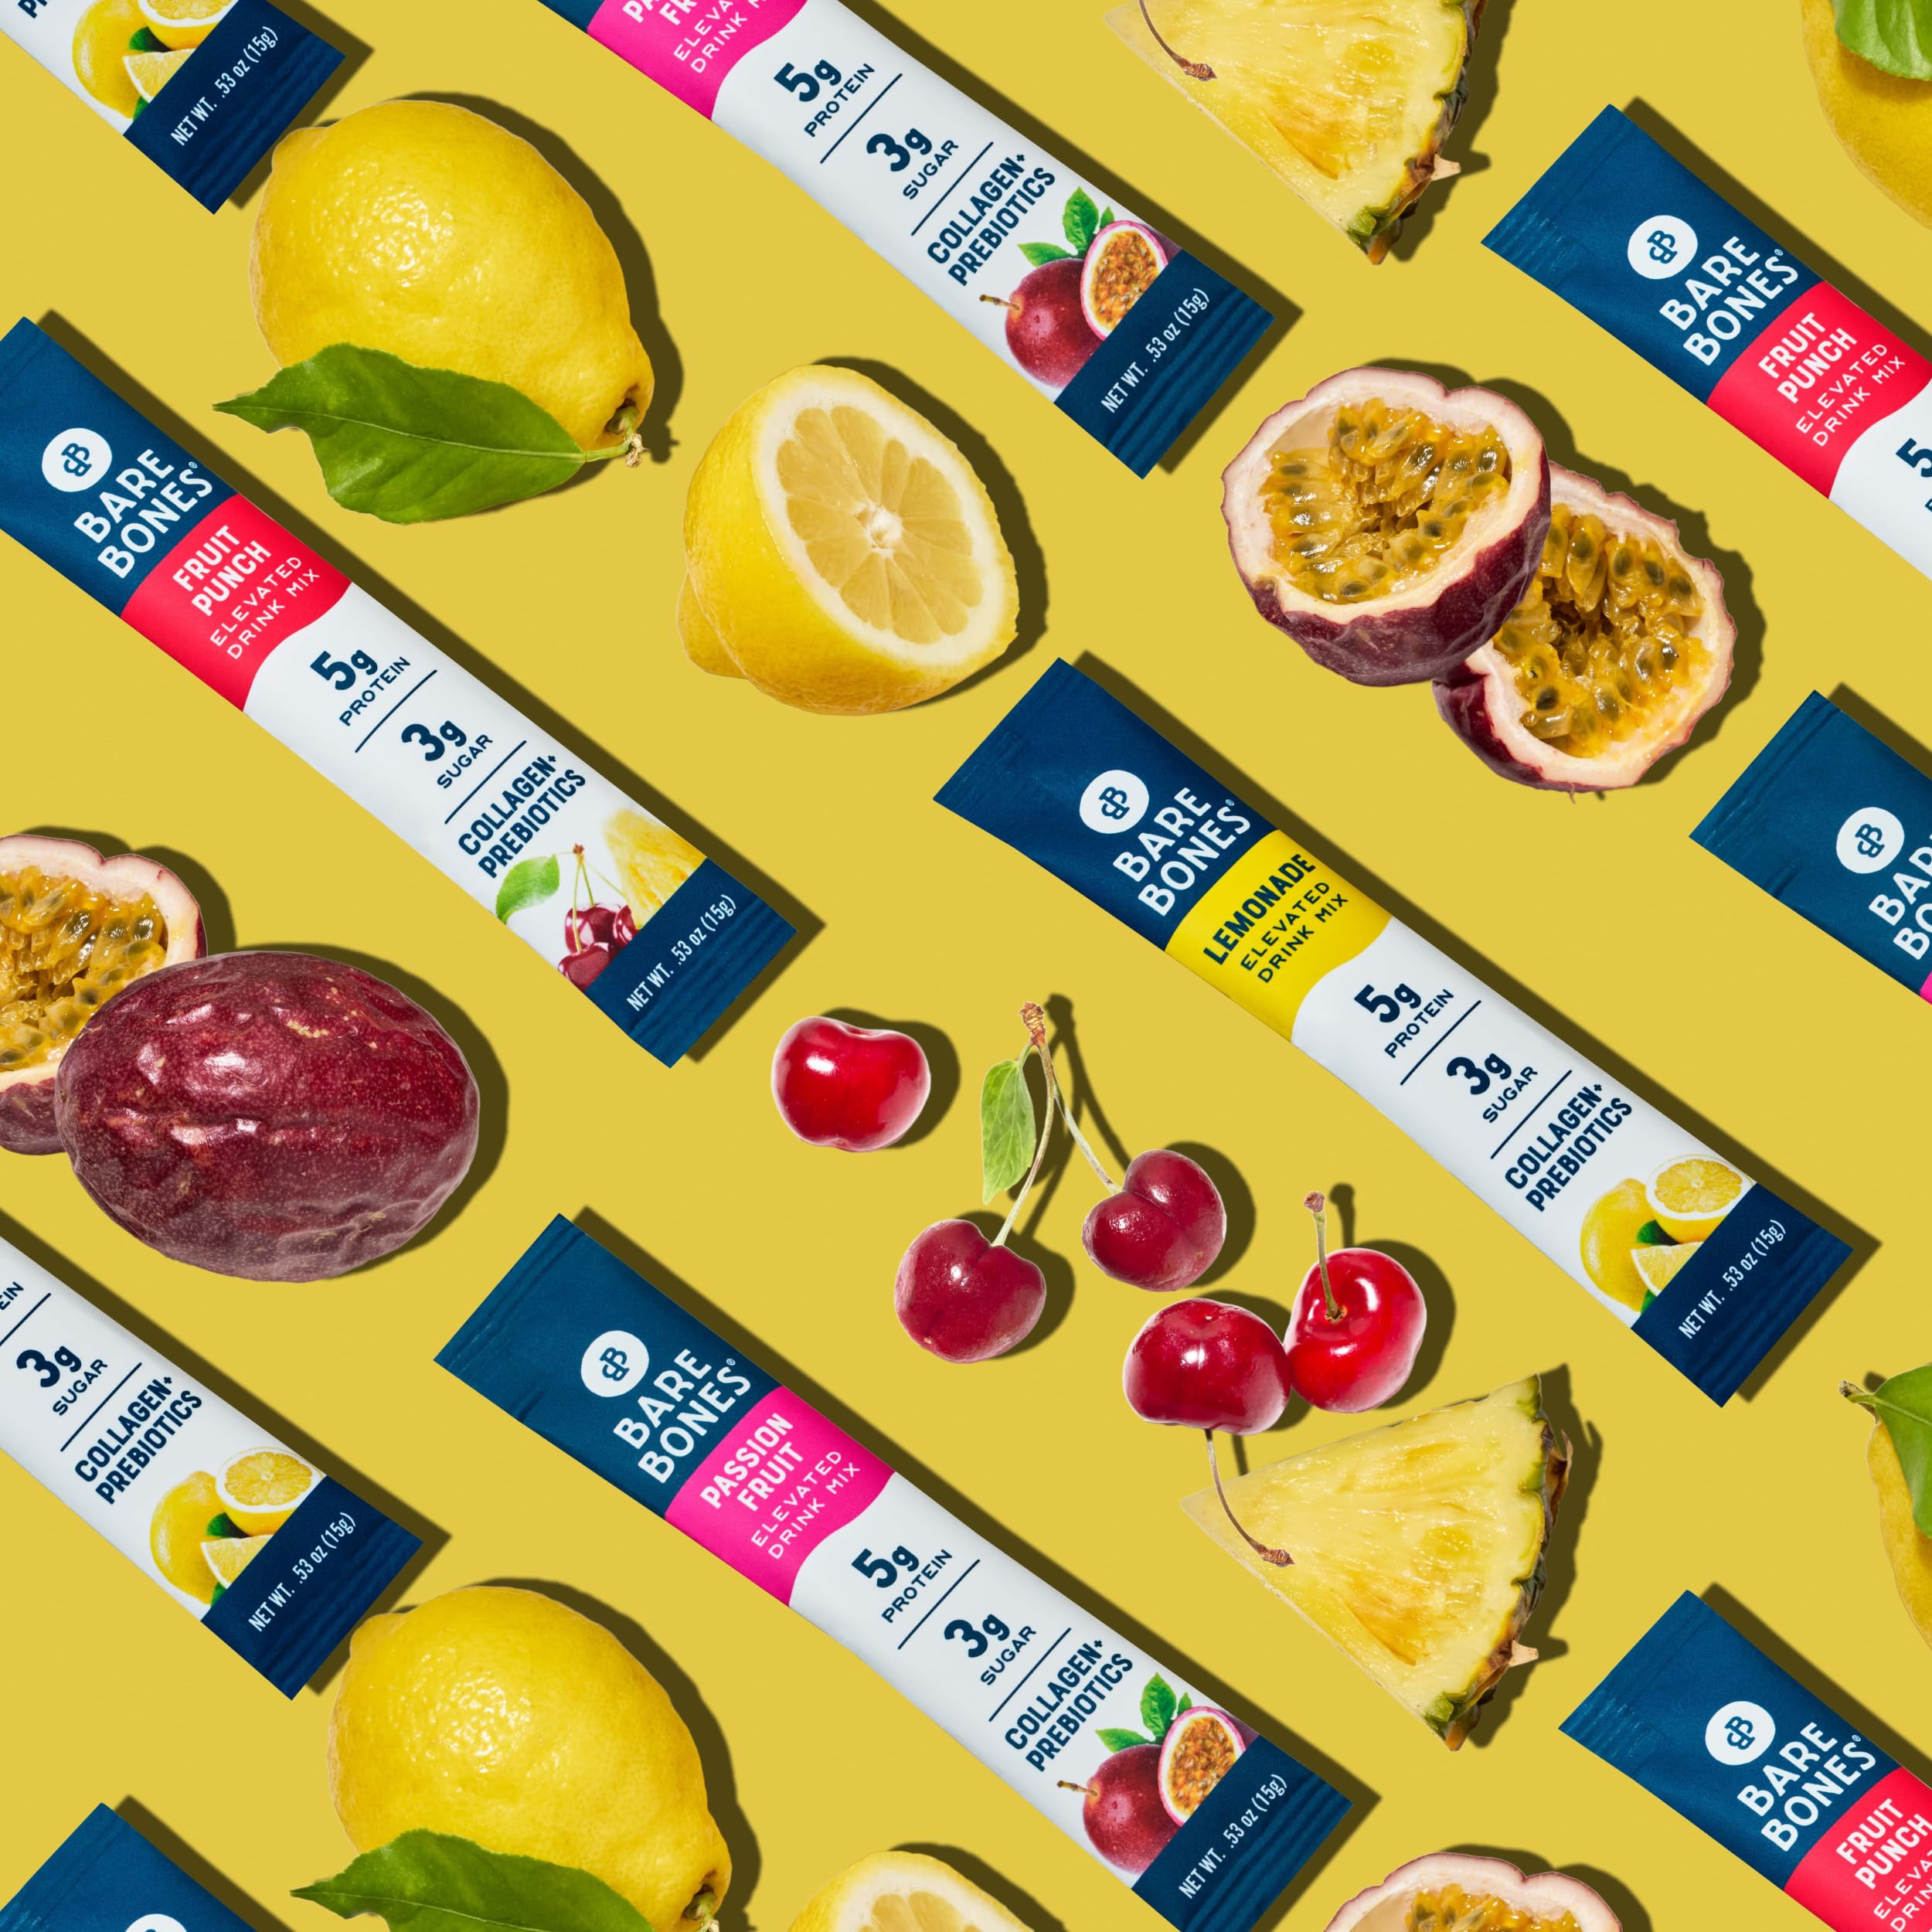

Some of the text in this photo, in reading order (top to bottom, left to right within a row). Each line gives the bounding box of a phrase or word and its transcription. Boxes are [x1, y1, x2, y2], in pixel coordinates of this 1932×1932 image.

[673, 0, 733, 61] ELEVA
[690, 12, 747, 73] DRINK
[171, 26, 278, 145] NET WT. .53 oz (15g)
[774, 60, 842, 102] 5g
[804, 63, 875, 138] PROTEIN
[866, 128, 933, 172] 3g
[903, 140, 959, 200] SUGAR
[927, 154, 1026, 264] COLLAGEN+
[947, 167, 1056, 287] PREBIOTICS
[1659, 236, 1760, 331] BARE
[1101, 288, 1209, 413] NET WT. .53 oz (15g)
[1758, 312, 1826, 379] FRUIT
[1777, 328, 1857, 403] PUNCH
[1795, 344, 1887, 434] ELEVATED
[1812, 356, 1905, 447] DRINK MIX
[73, 449, 175, 543] BARE
[1896, 437, 1932, 478] 5
[172, 525, 240, 592] FRUIT
[191, 540, 271, 617] PUNCH
[209, 557, 301, 647] ELEVATED
[226, 569, 319, 659] DRINK MIX
[310, 649, 378, 691] 5g
[339, 656, 411, 726] PROTEIN
[401, 720, 467, 761] 3g
[437, 734, 493, 789] SUGAR
[458, 755, 556, 855] COLLAGEN+
[478, 769, 586, 879] PREBIOTICS
[1112, 787, 1212, 883] BARE
[1202, 853, 1316, 965] LEMONADE
[1869, 833, 1932, 926] BAR
[627, 894, 736, 1011] NET WT. .53 oz (15g)
[1240, 882, 1330, 971] ELEVATED
[1257, 893, 1349, 984] DRINK MIX
[1353, 983, 1422, 1023] 5g
[1384, 988, 1454, 1059] PROTEIN
[1446, 1053, 1512, 1095] 3g
[1482, 1066, 1538, 1124] SUGAR
[1505, 1083, 1603, 1189] COLLAGEN+
[1526, 1097, 1632, 1213] PREBIOTICS
[1679, 1219, 1786, 1339] NET WT. .53 oz (15g)
[16, 1345, 82, 1388] 3g
[53, 1359, 108, 1416] SUGAR
[613, 1349, 712, 1449] BARE
[75, 1376, 172, 1482] COLLAGEN+
[95, 1390, 202, 1505] PREBIOTICS
[699, 1413, 794, 1509] PASSION
[736, 1441, 804, 1512] FRUIT
[750, 1451, 842, 1547] ELEVATED
[767, 1462, 860, 1560] DRINK MIX
[248, 1512, 355, 1631] NET WT. .53 oz (15g)
[851, 1545, 920, 1588] 5g
[881, 1549, 953, 1624] PROTEIN
[944, 1614, 1010, 1658] 3g
[980, 1626, 1036, 1685] SUGAR
[1005, 1640, 1103, 1750] COLLAGEN+
[1026, 1653, 1133, 1772] PREBIOTICS
[1736, 1722, 1838, 1817] BARE
[1179, 1774, 1287, 1899] NET WT. .53 oz (15g)
[1835, 1798, 1903, 1865] FRUIT
[1854, 1813, 1932, 1889] PUNCH
[1873, 1849, 1932, 1920] ELEVA
[1889, 1883, 1932, 1932] DRIN
